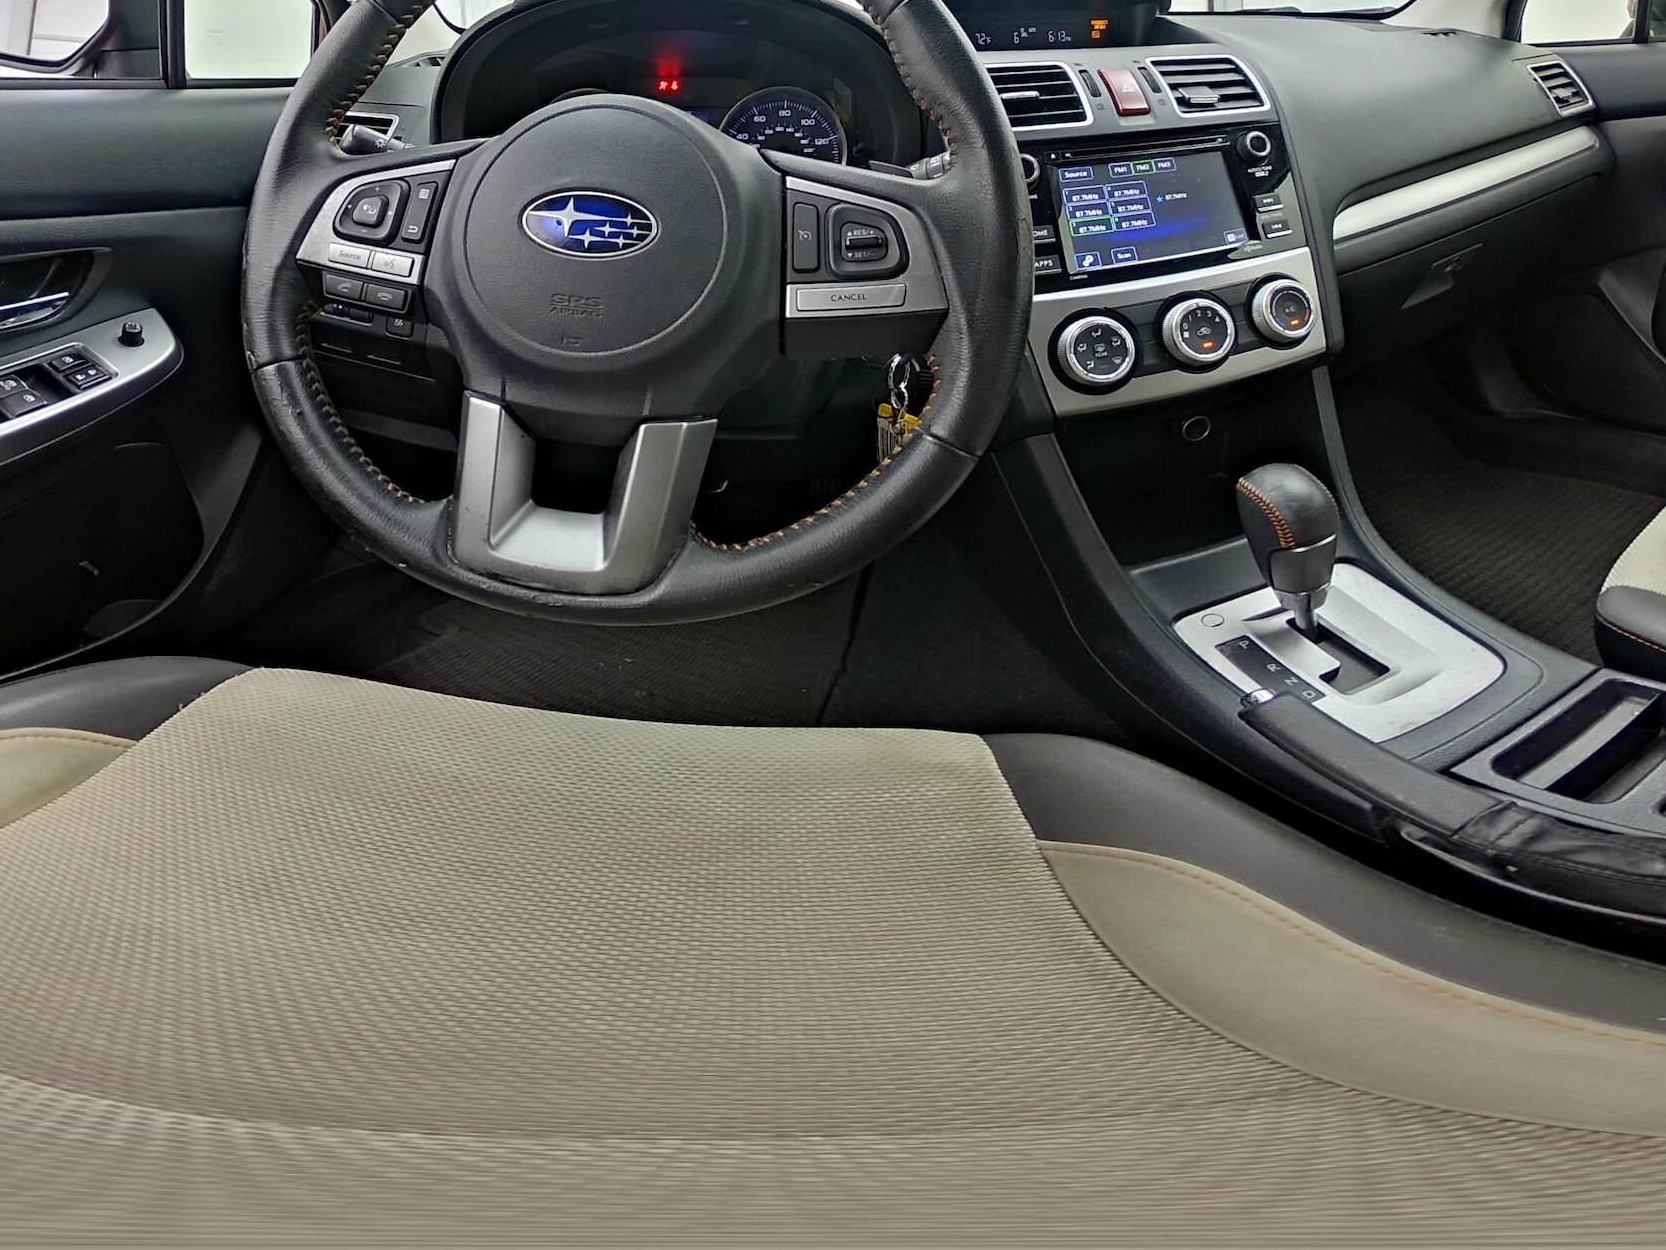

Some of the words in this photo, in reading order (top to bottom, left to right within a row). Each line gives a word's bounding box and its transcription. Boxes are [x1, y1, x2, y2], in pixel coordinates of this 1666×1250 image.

[778, 109, 791, 117] 80
[753, 115, 766, 123] 60
[800, 118, 815, 126] 100
[736, 133, 749, 141] 40
[814, 138, 829, 146] 120
[1136, 163, 1150, 171] FM2
[1158, 161, 1171, 169] FM3
[1064, 170, 1088, 179] Source
[1114, 166, 1127, 174] FM1
[1071, 193, 1099, 202] 87.7MHz
[1114, 189, 1140, 198] 87.7MHz
[1117, 203, 1144, 213] 87.7MHz
[1075, 209, 1103, 218] 87.7MHz
[1121, 219, 1148, 229] 87.7MHz
[1079, 225, 1106, 234] 87.7MHz
[339, 250, 362, 260] Source
[1117, 252, 1132, 260] Scan
[1034, 259, 1053, 268] APPS
[550, 293, 604, 309] SRS
[830, 292, 867, 302] CANCEL
[1196, 310, 1202, 318] 2
[1205, 309, 1212, 318] 3
[1239, 640, 1250, 649] P
[1266, 663, 1281, 672] R
[1302, 690, 1316, 699] D
